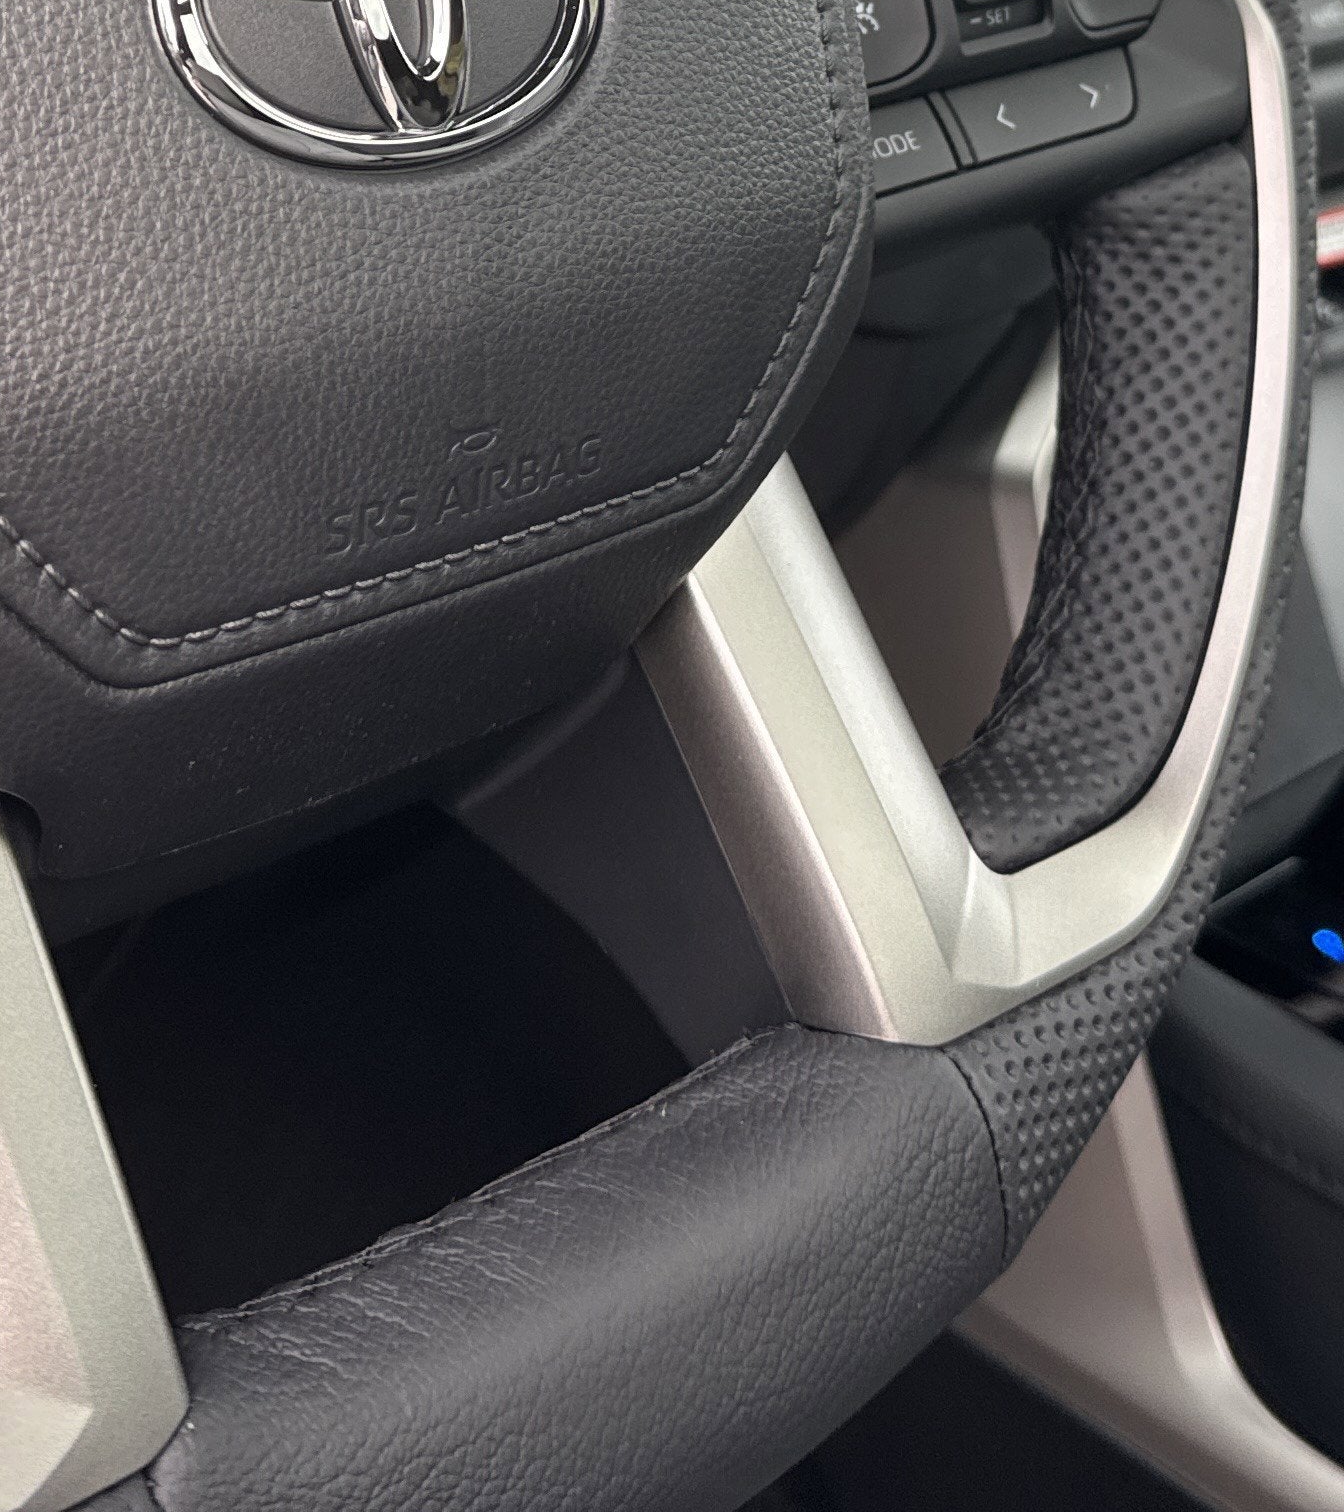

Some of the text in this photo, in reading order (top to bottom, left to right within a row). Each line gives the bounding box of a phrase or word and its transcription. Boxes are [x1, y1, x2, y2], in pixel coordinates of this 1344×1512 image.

[871, 129, 921, 160] ODE
[325, 437, 604, 561] SRS AIRBAG
